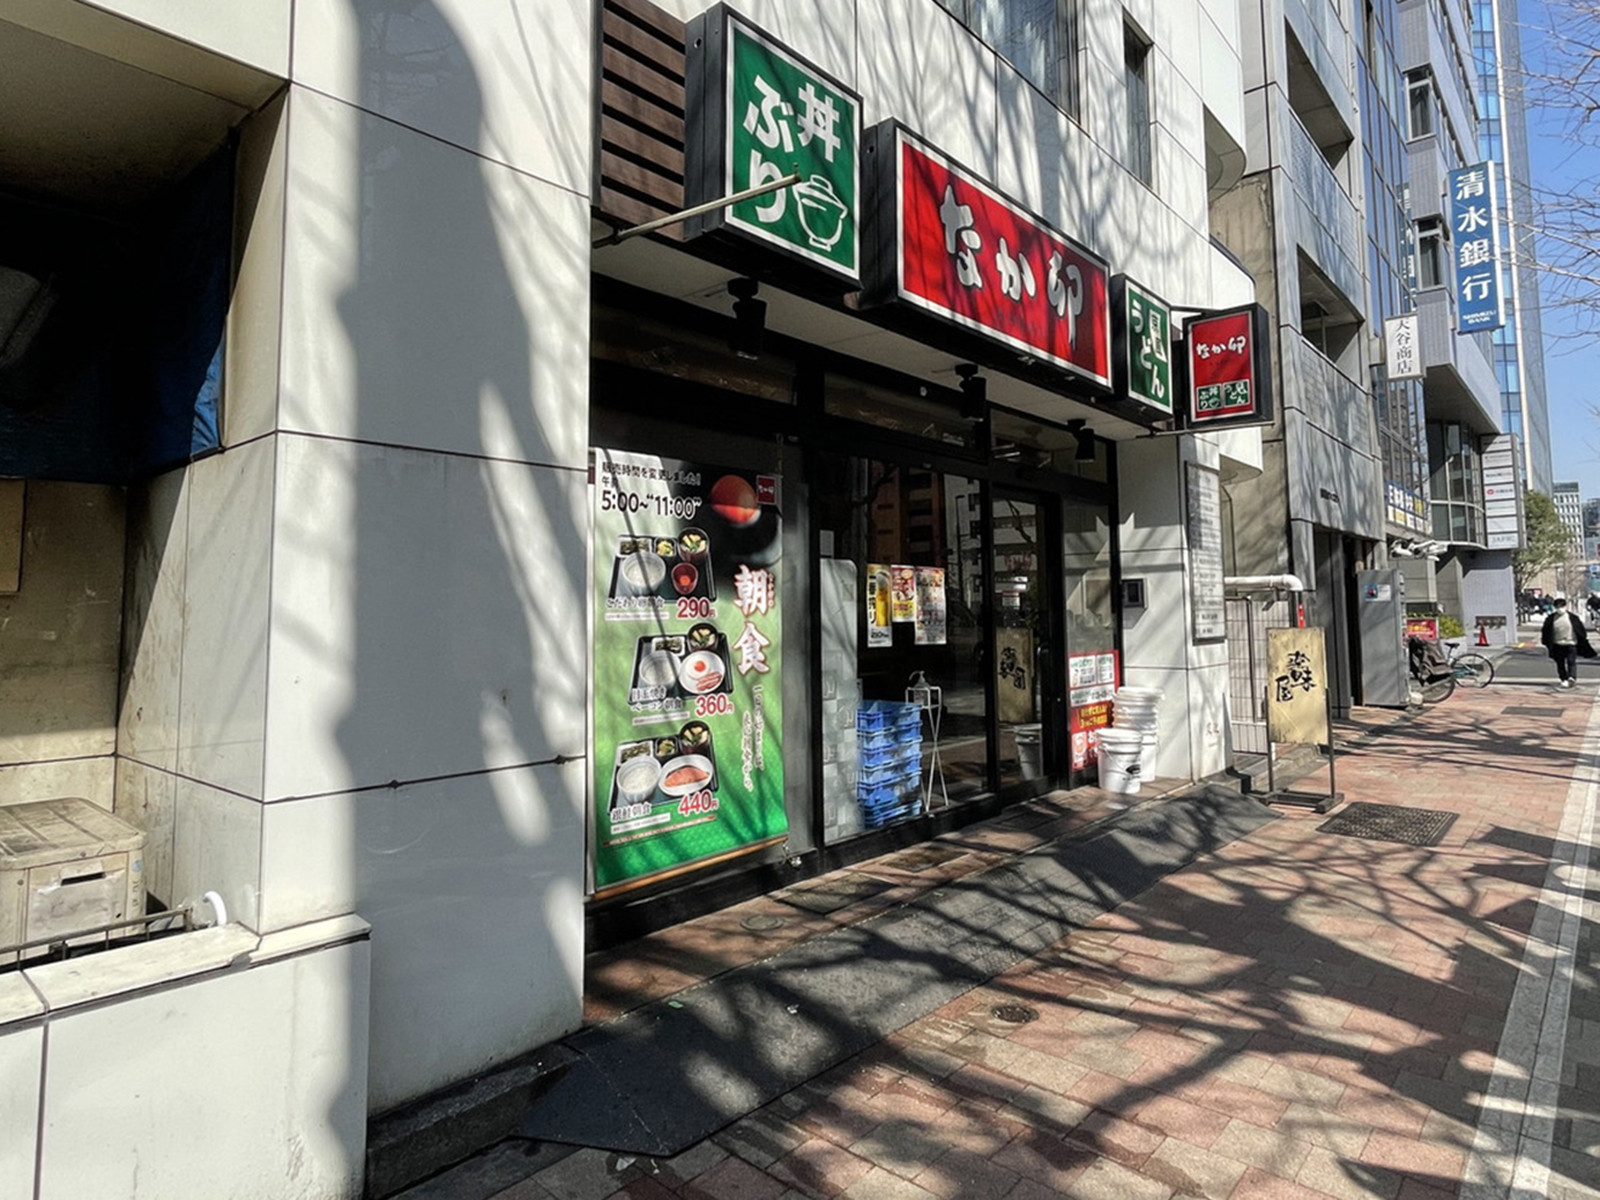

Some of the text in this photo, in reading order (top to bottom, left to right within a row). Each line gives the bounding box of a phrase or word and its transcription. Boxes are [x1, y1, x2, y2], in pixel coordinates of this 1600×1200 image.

[742, 74, 795, 223] ぶり
[797, 82, 841, 163] 丼
[939, 184, 1084, 350] なか卯
[1455, 169, 1493, 302] 清水銀行
[1131, 298, 1165, 399] うどん
[1195, 335, 1247, 360] なか卯
[1462, 310, 1497, 320] SHIMIZU
[1467, 316, 1491, 324] BANK
[733, 564, 771, 676] 朝食
